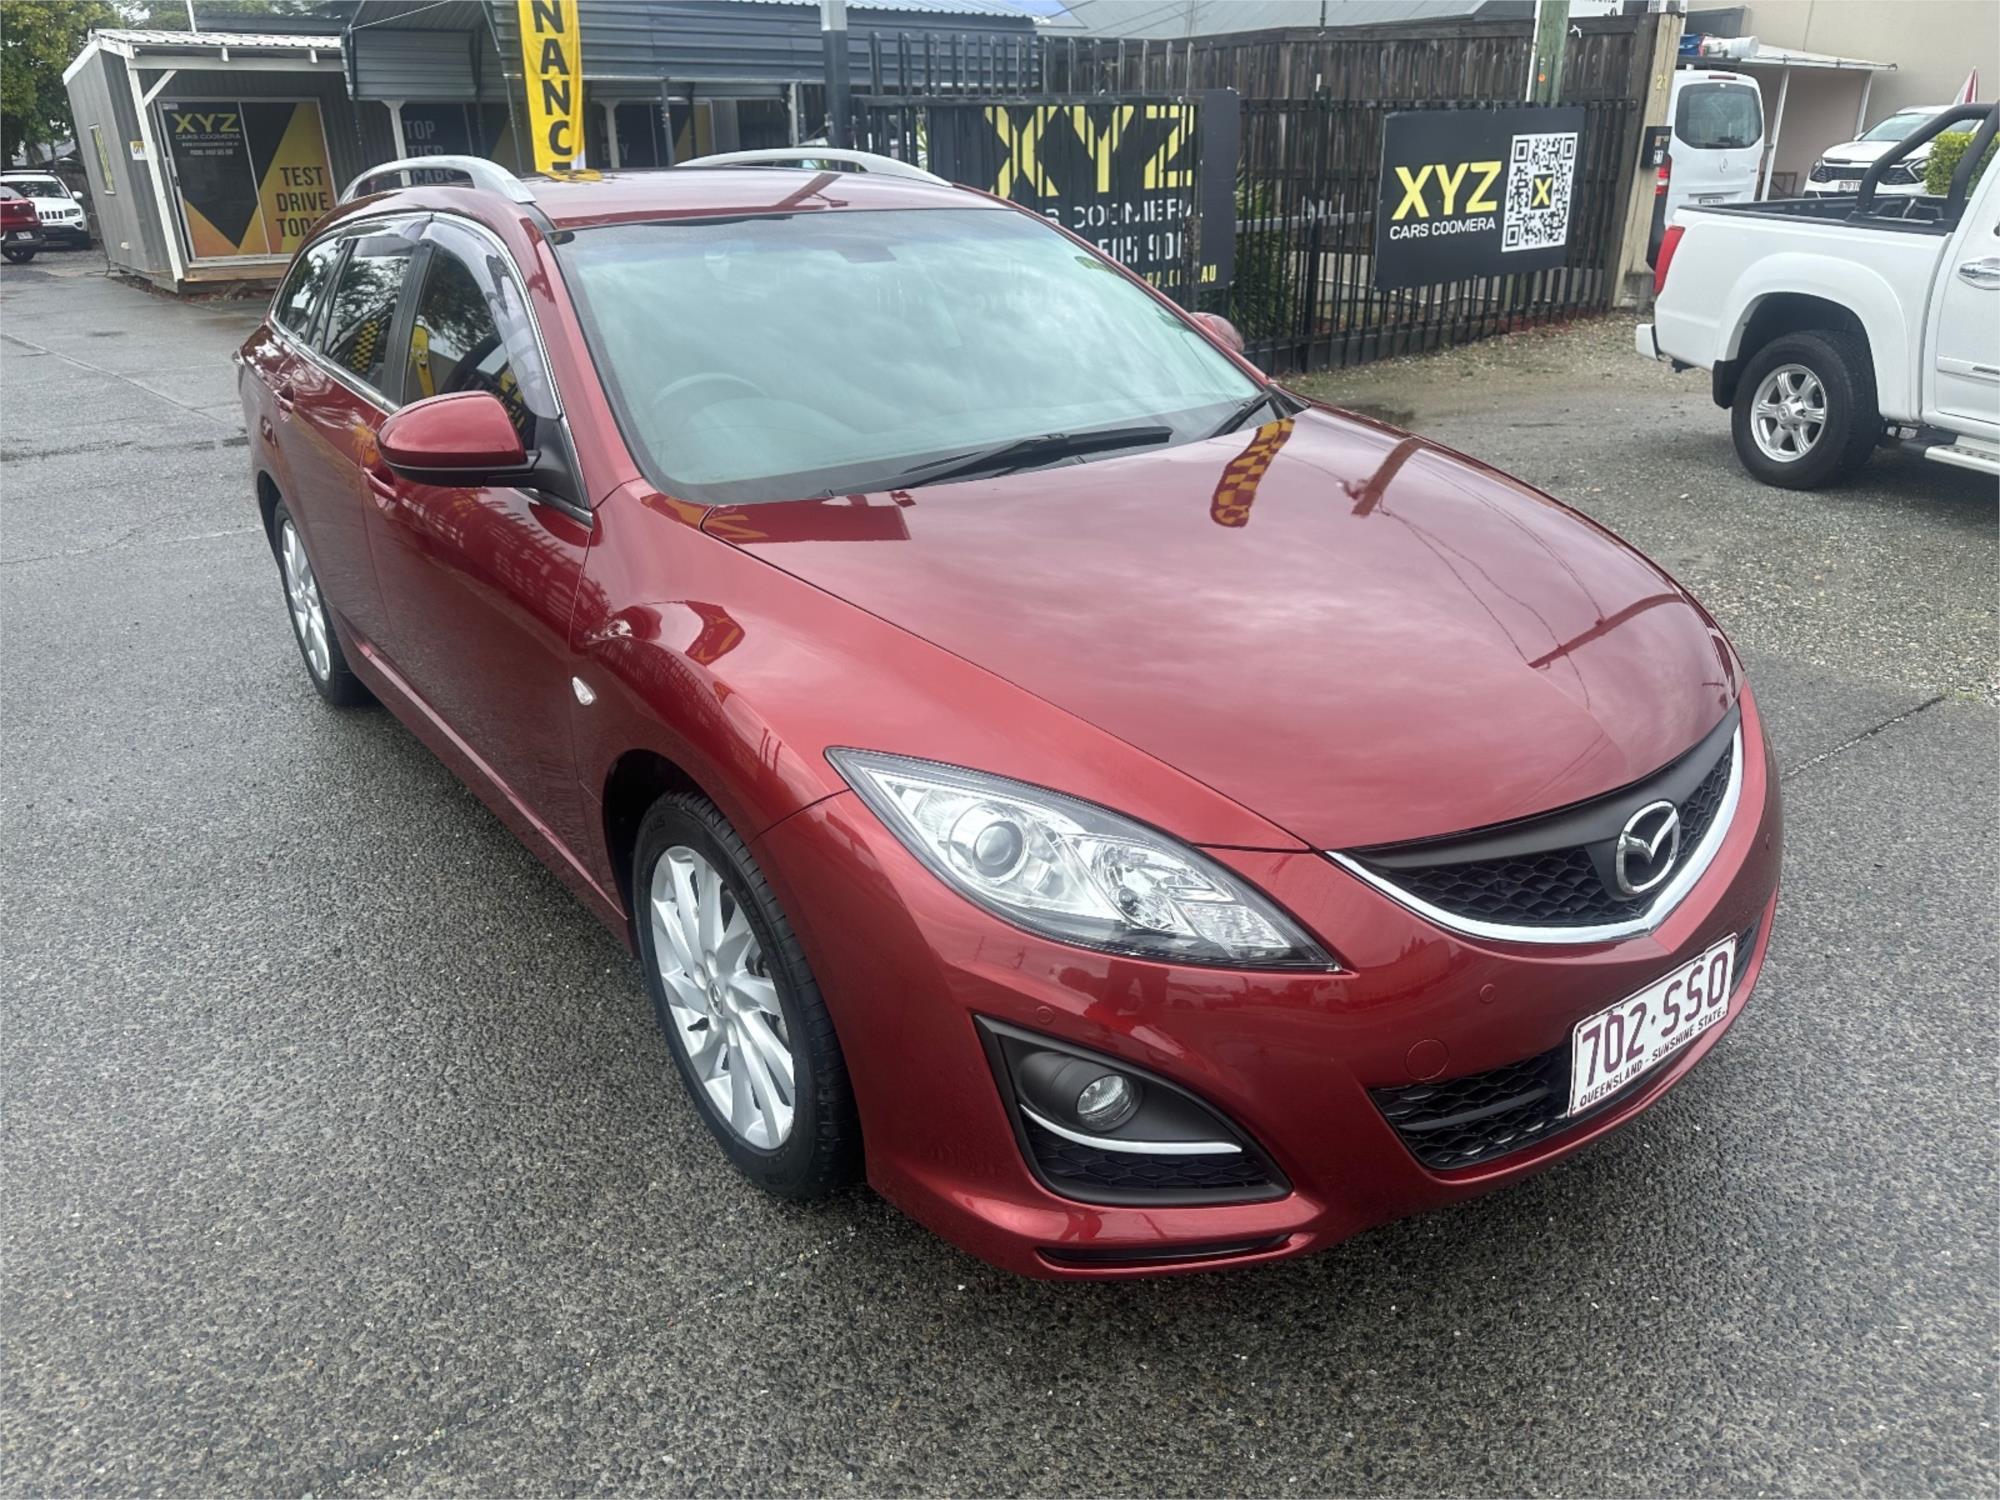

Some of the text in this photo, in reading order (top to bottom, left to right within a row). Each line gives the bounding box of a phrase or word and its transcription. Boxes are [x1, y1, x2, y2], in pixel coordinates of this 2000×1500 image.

[171, 113, 240, 133] XYZ
[404, 120, 435, 139] TOP
[985, 104, 1195, 199] XYZ
[280, 167, 323, 186] TEST
[1391, 161, 1502, 220] XYZ
[1532, 177, 1552, 207] X
[276, 192, 330, 212] DRIVE
[276, 218, 318, 237] TOD
[1389, 217, 1495, 240] CARS COOMERA
[1580, 1060, 1643, 1106] QUEENSLAND
[1652, 1027, 1694, 1062] SUNSHINE
